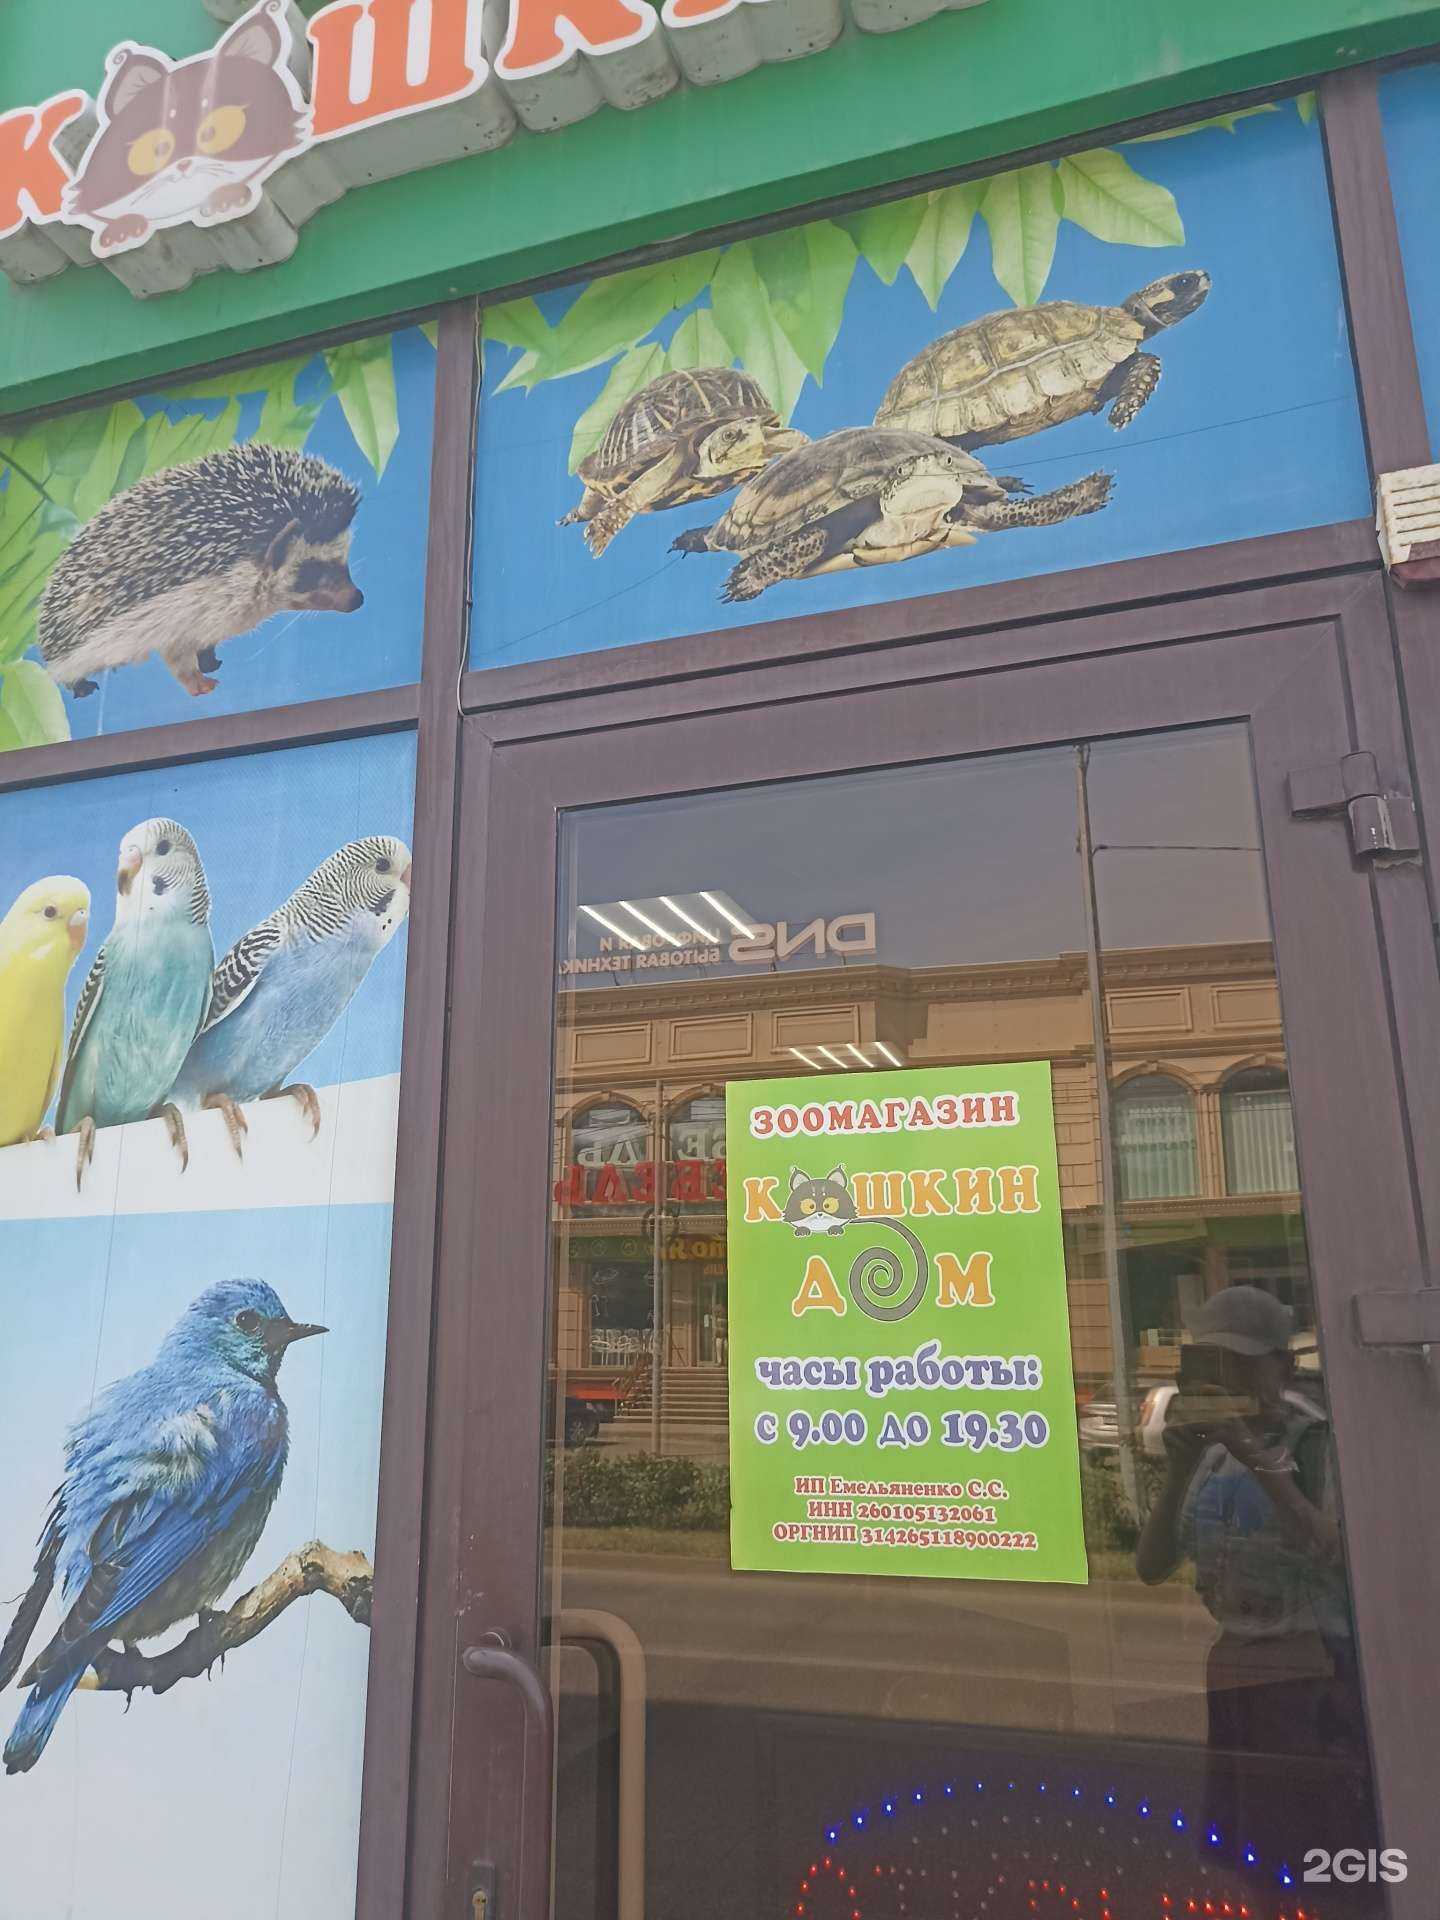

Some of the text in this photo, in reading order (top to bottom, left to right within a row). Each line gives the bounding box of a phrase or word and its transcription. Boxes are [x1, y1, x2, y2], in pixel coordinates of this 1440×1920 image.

[752, 1093, 1017, 1136] ЗООМАГАЗИН
[757, 1342, 1041, 1394] часы работы:
[788, 1411, 867, 1448] 9.00
[943, 1412, 1048, 1450] 19.30
[795, 1477, 1009, 1499] ИП Емельяненко С.С.
[808, 1501, 996, 1523] ИНН 260105132061
[773, 1524, 1038, 1550] ОРГНИП 314265118900222
